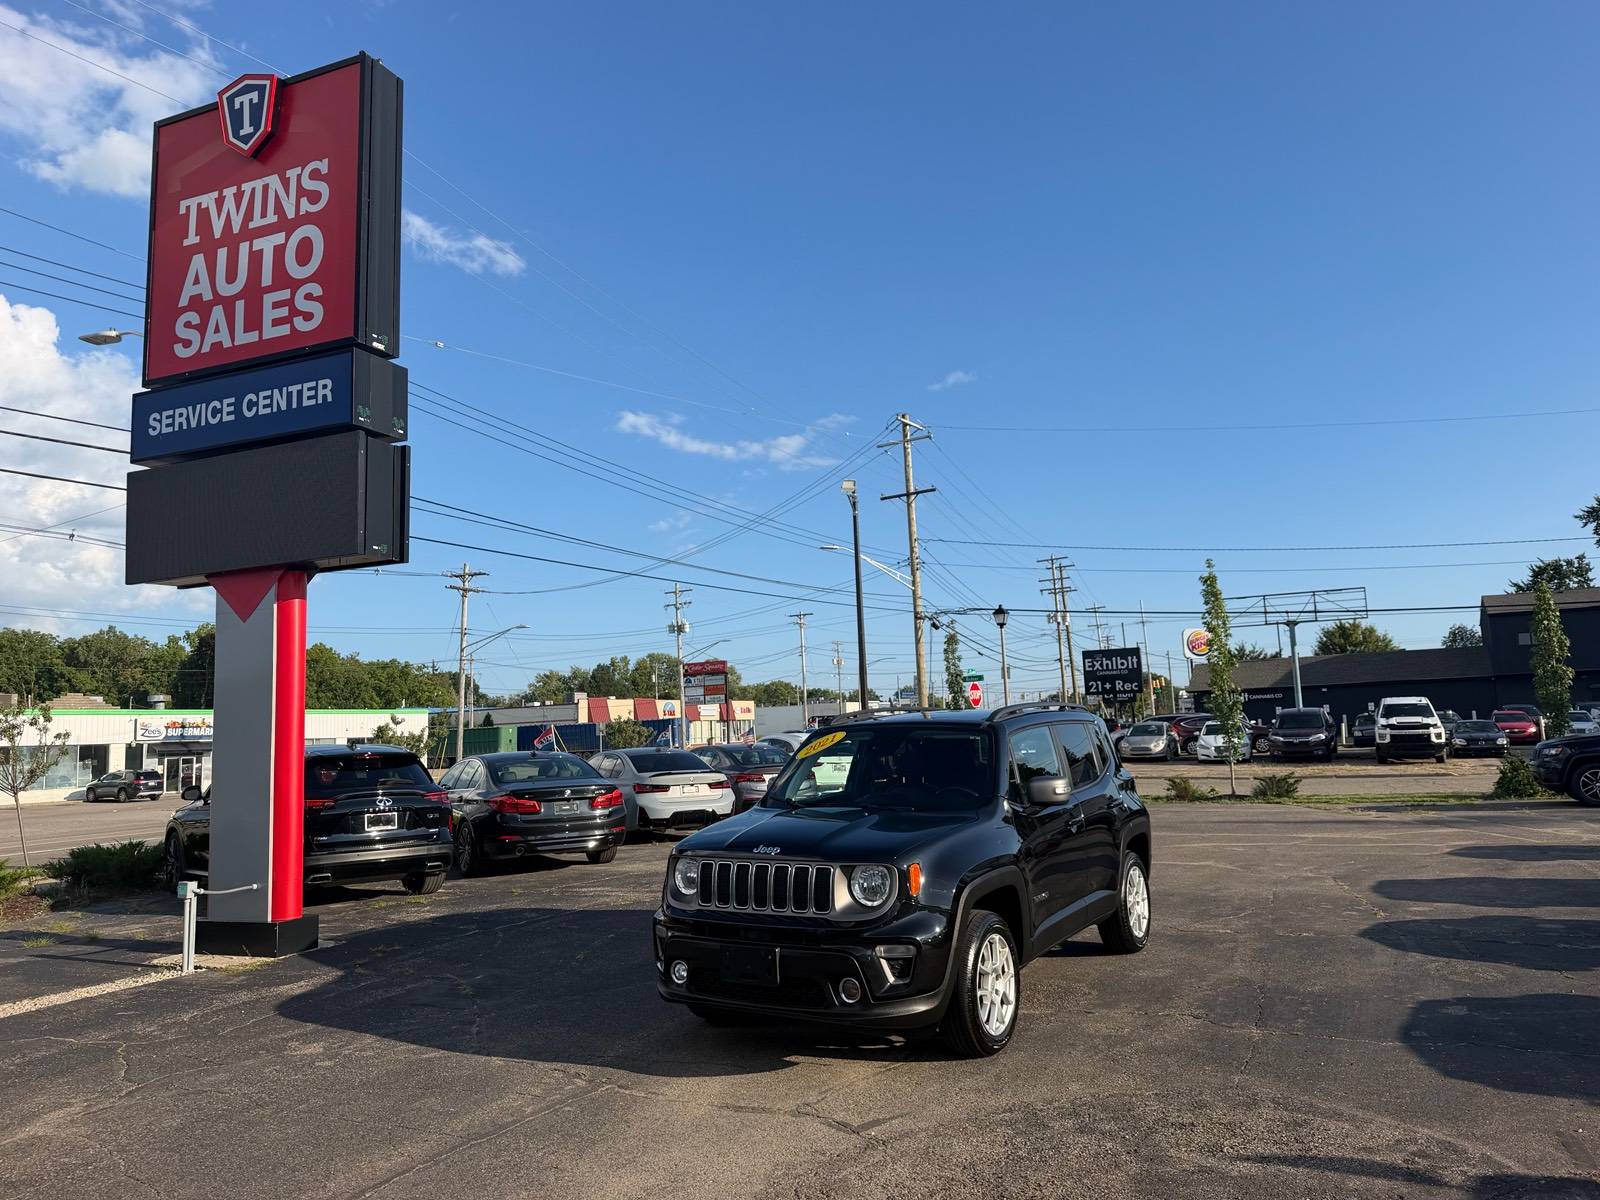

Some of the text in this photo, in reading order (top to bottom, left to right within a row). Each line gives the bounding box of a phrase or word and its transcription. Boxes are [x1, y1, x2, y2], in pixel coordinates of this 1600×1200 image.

[234, 91, 258, 136] T
[179, 158, 330, 246] TWINS
[178, 224, 324, 307] AUTO
[173, 282, 324, 358] SALES
[148, 378, 332, 436] SERVICE CENTER
[1085, 656, 1138, 671] Exhibit
[970, 690, 981, 699] STOP
[1088, 680, 1138, 692] 21+ Rec
[804, 734, 837, 755] 2021
[752, 844, 781, 856] Jeep
